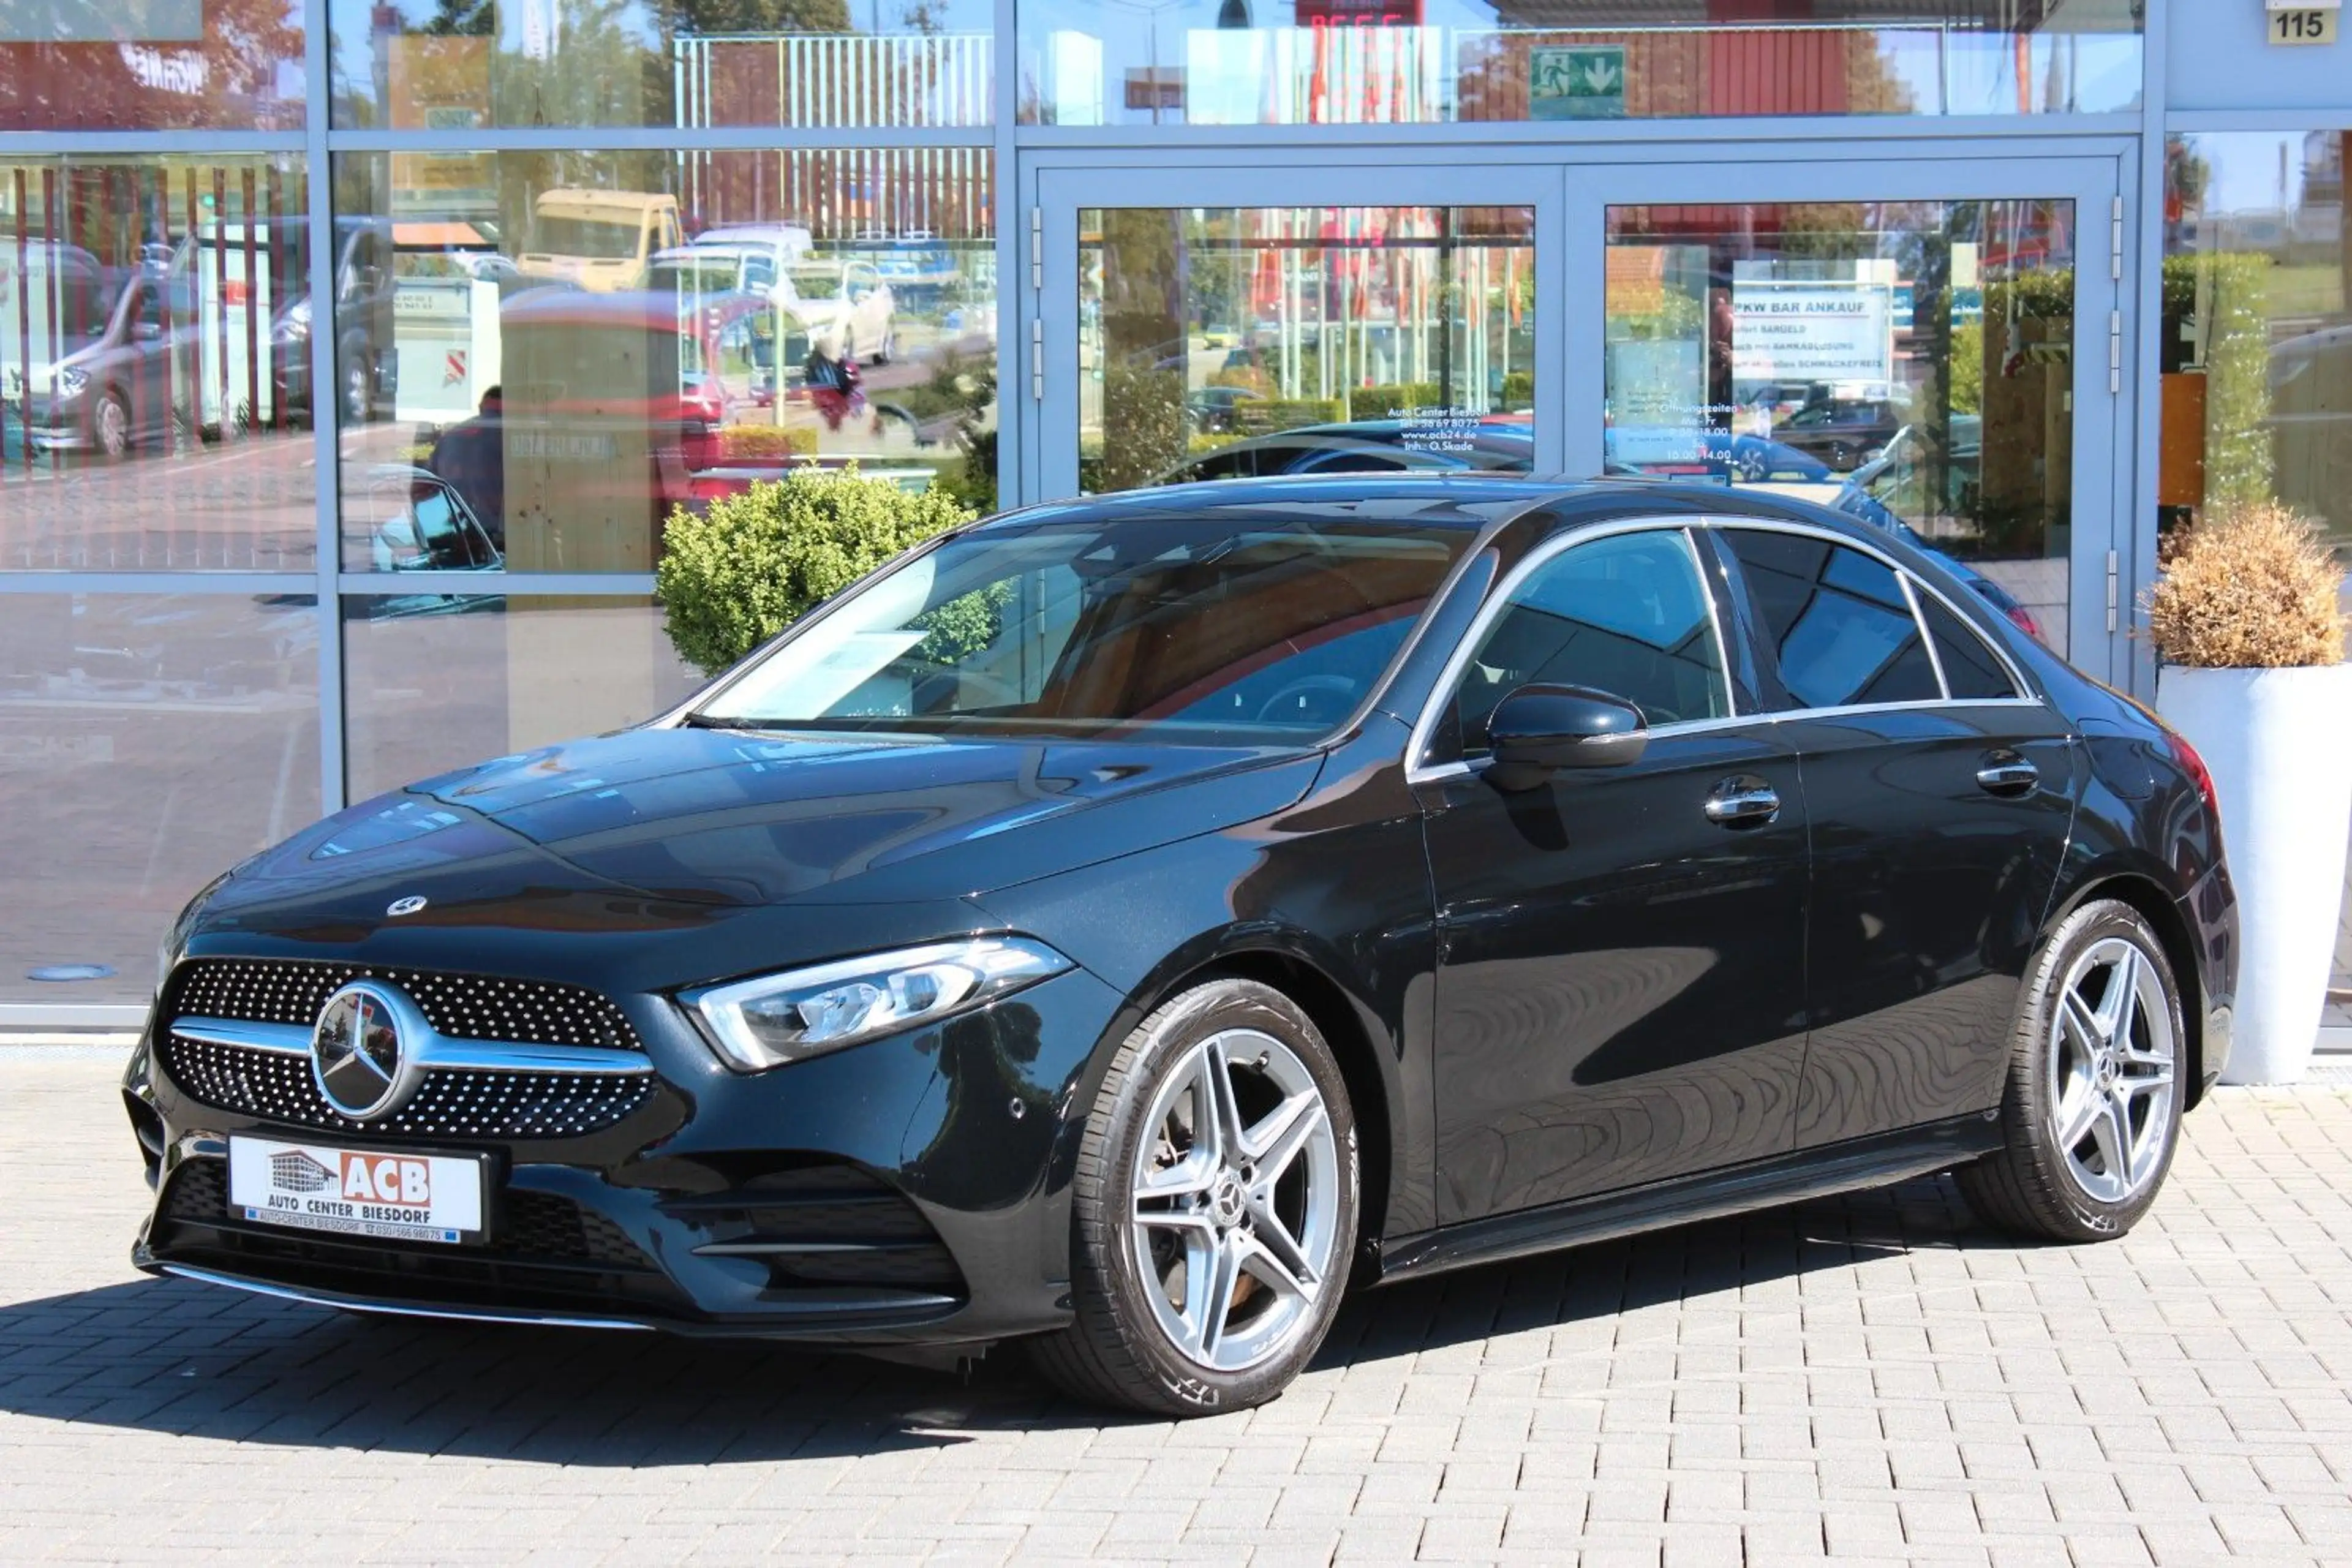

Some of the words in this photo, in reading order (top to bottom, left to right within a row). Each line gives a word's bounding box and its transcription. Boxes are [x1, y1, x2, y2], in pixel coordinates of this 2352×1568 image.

[2277, 12, 2324, 37] 115
[1735, 302, 1766, 312] PKW
[1771, 302, 1800, 312] BAR
[1806, 302, 1866, 312] ANKAUF
[1388, 407, 1412, 417] Auto
[1414, 407, 1449, 417] Center
[344, 1155, 429, 1204] ACB
[268, 1194, 300, 1210] AUTO
[307, 1199, 353, 1218] CENTER
[363, 1205, 431, 1224] BIESDORF
